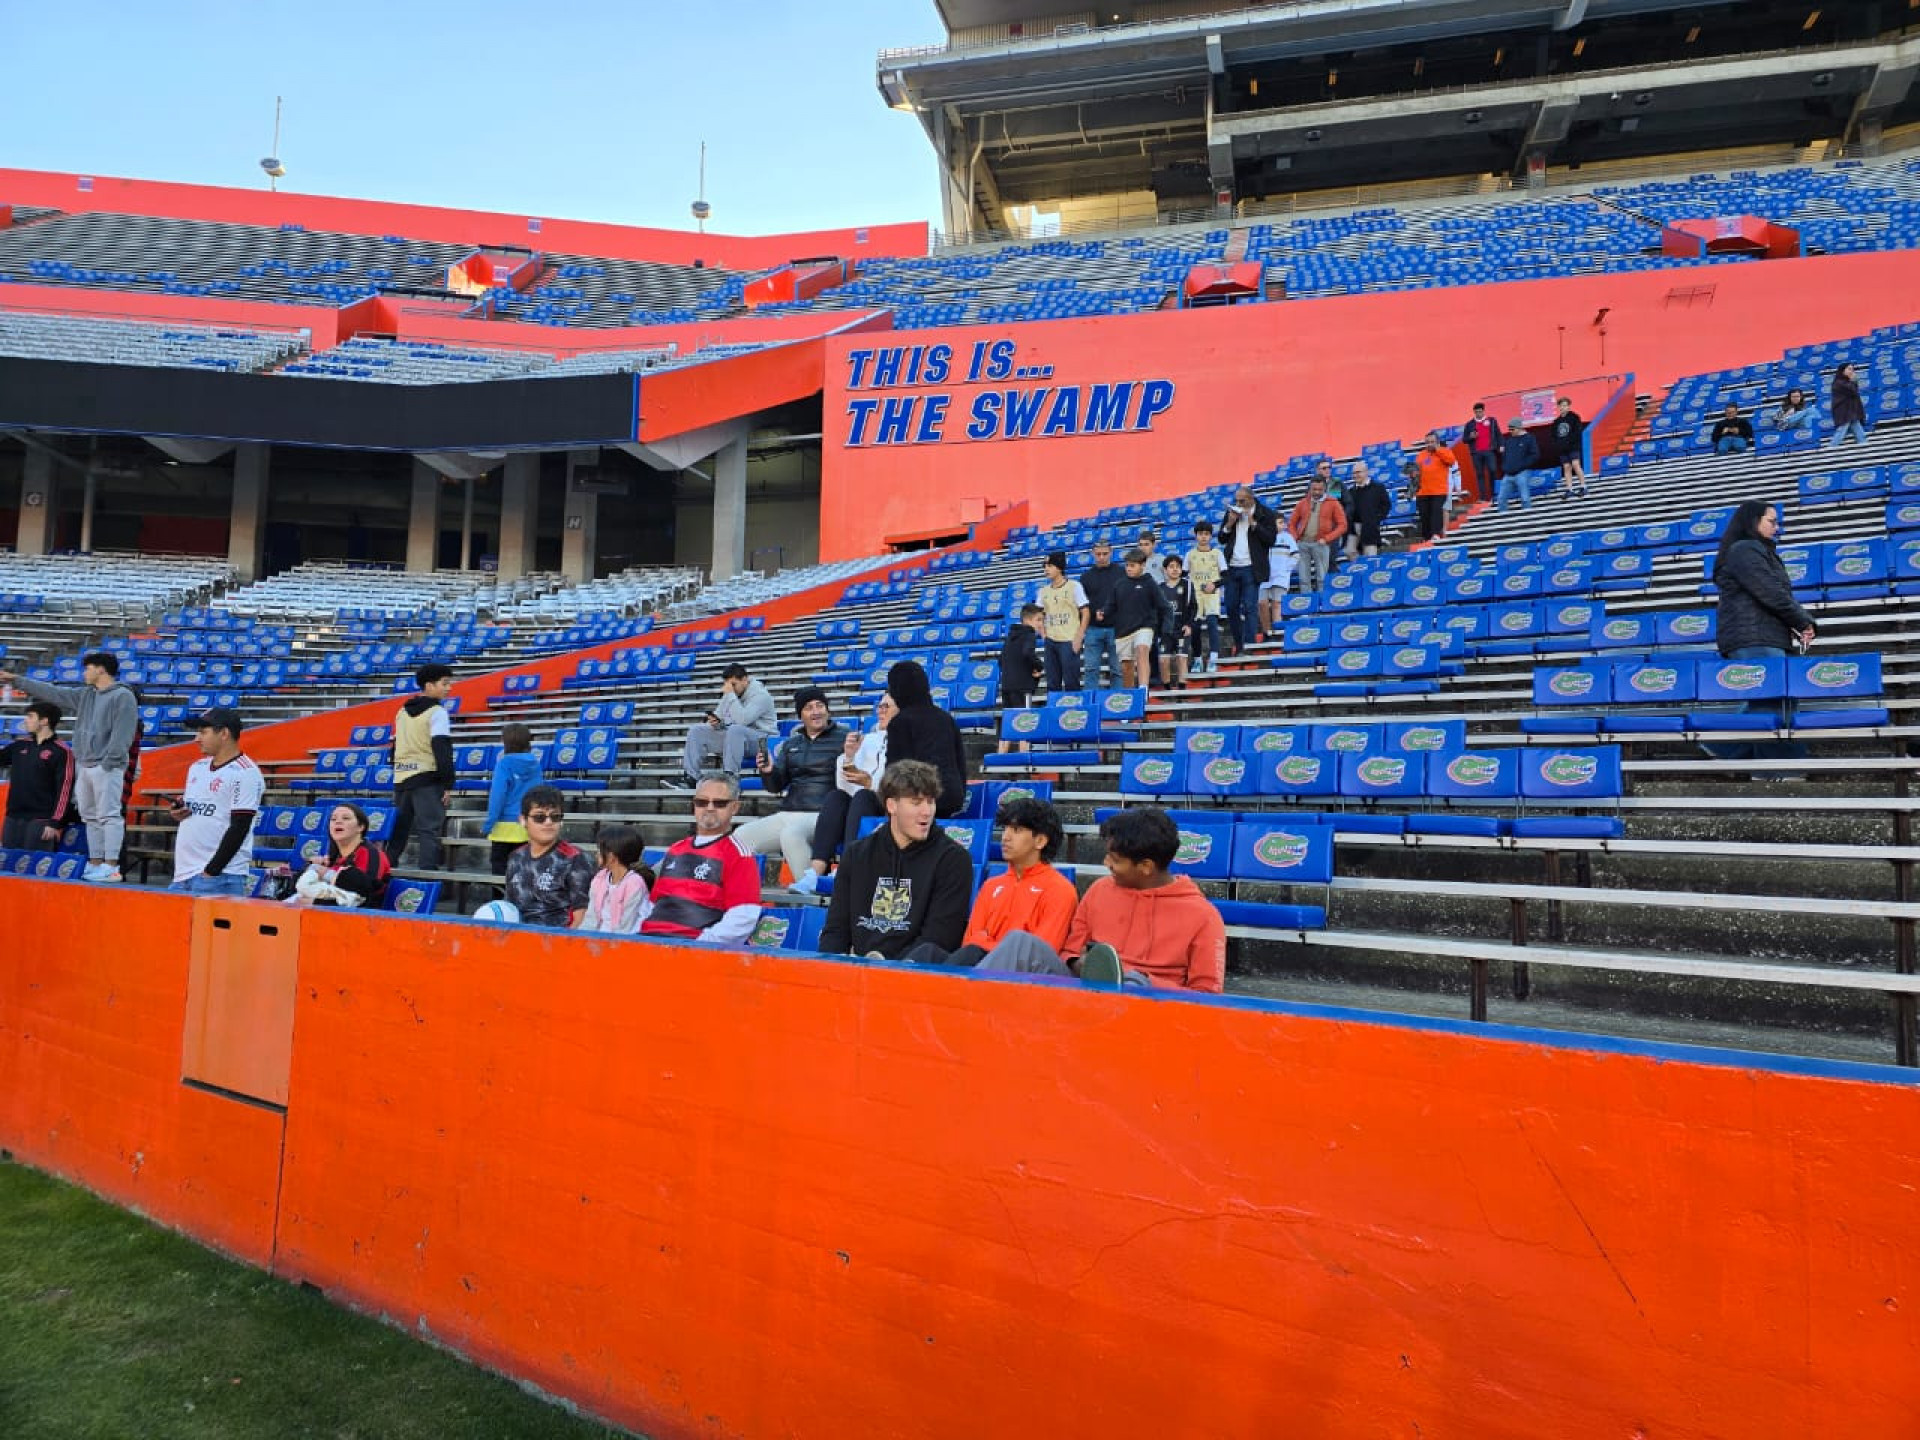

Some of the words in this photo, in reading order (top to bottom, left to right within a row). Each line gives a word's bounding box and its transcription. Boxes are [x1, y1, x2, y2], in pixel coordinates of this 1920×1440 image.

[846, 344, 952, 390] THIS
[967, 340, 1055, 382] IS...
[844, 394, 951, 447] THE
[966, 379, 1175, 441] SWAMP
